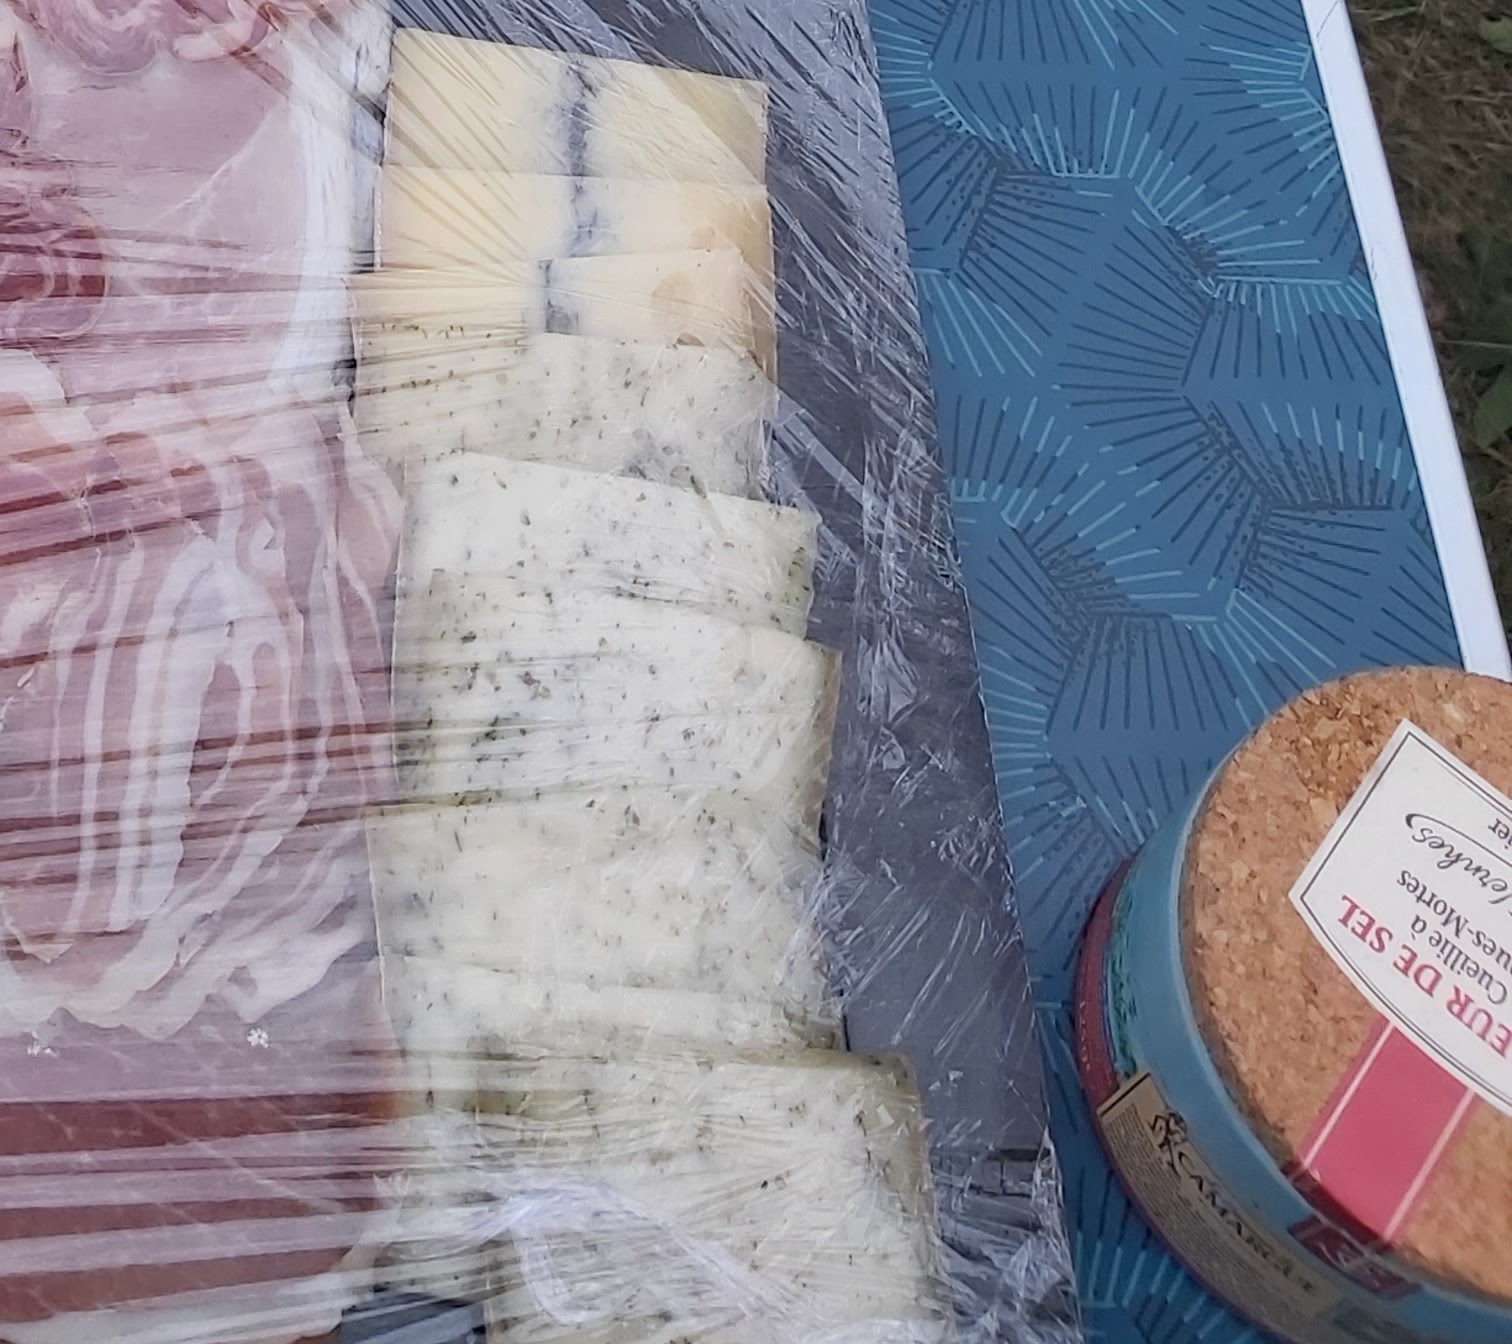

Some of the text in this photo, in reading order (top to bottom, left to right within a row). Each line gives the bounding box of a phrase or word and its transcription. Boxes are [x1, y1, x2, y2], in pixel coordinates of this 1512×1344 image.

[1337, 893, 1393, 954] SEL
[1392, 943, 1444, 999] DE
[1410, 914, 1508, 1005] Cueillie à
